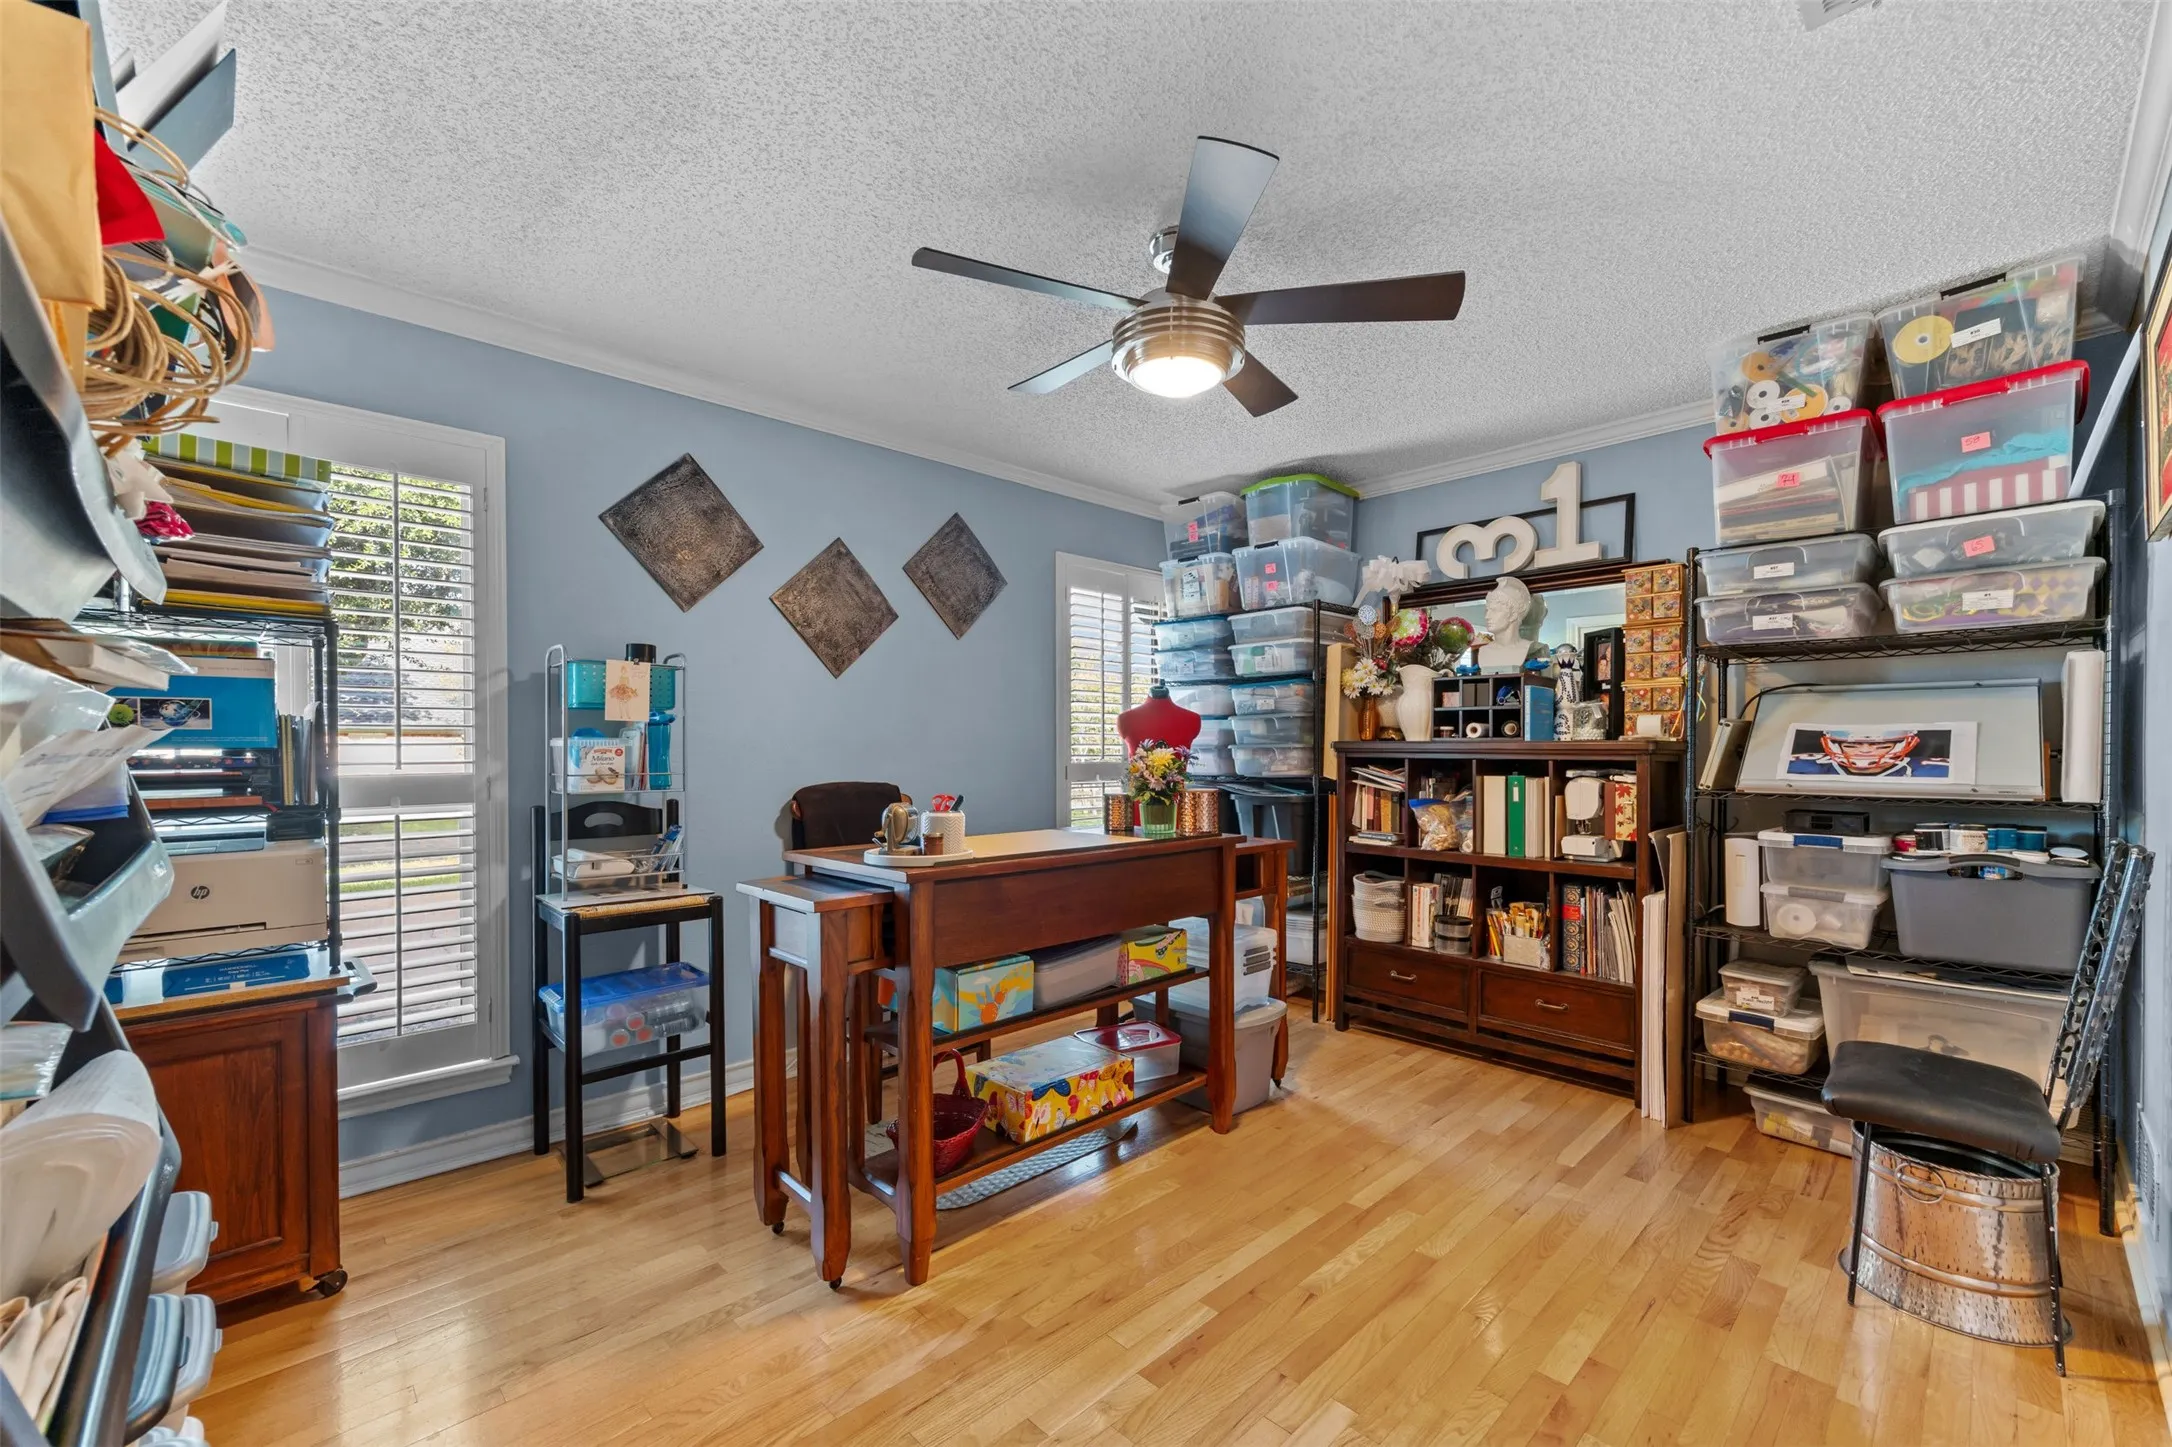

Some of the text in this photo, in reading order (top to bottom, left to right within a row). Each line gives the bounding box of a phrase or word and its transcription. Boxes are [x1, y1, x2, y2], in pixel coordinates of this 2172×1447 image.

[1534, 460, 1603, 569] 1
[591, 754, 615, 762] Milano
[191, 885, 210, 900] hp
